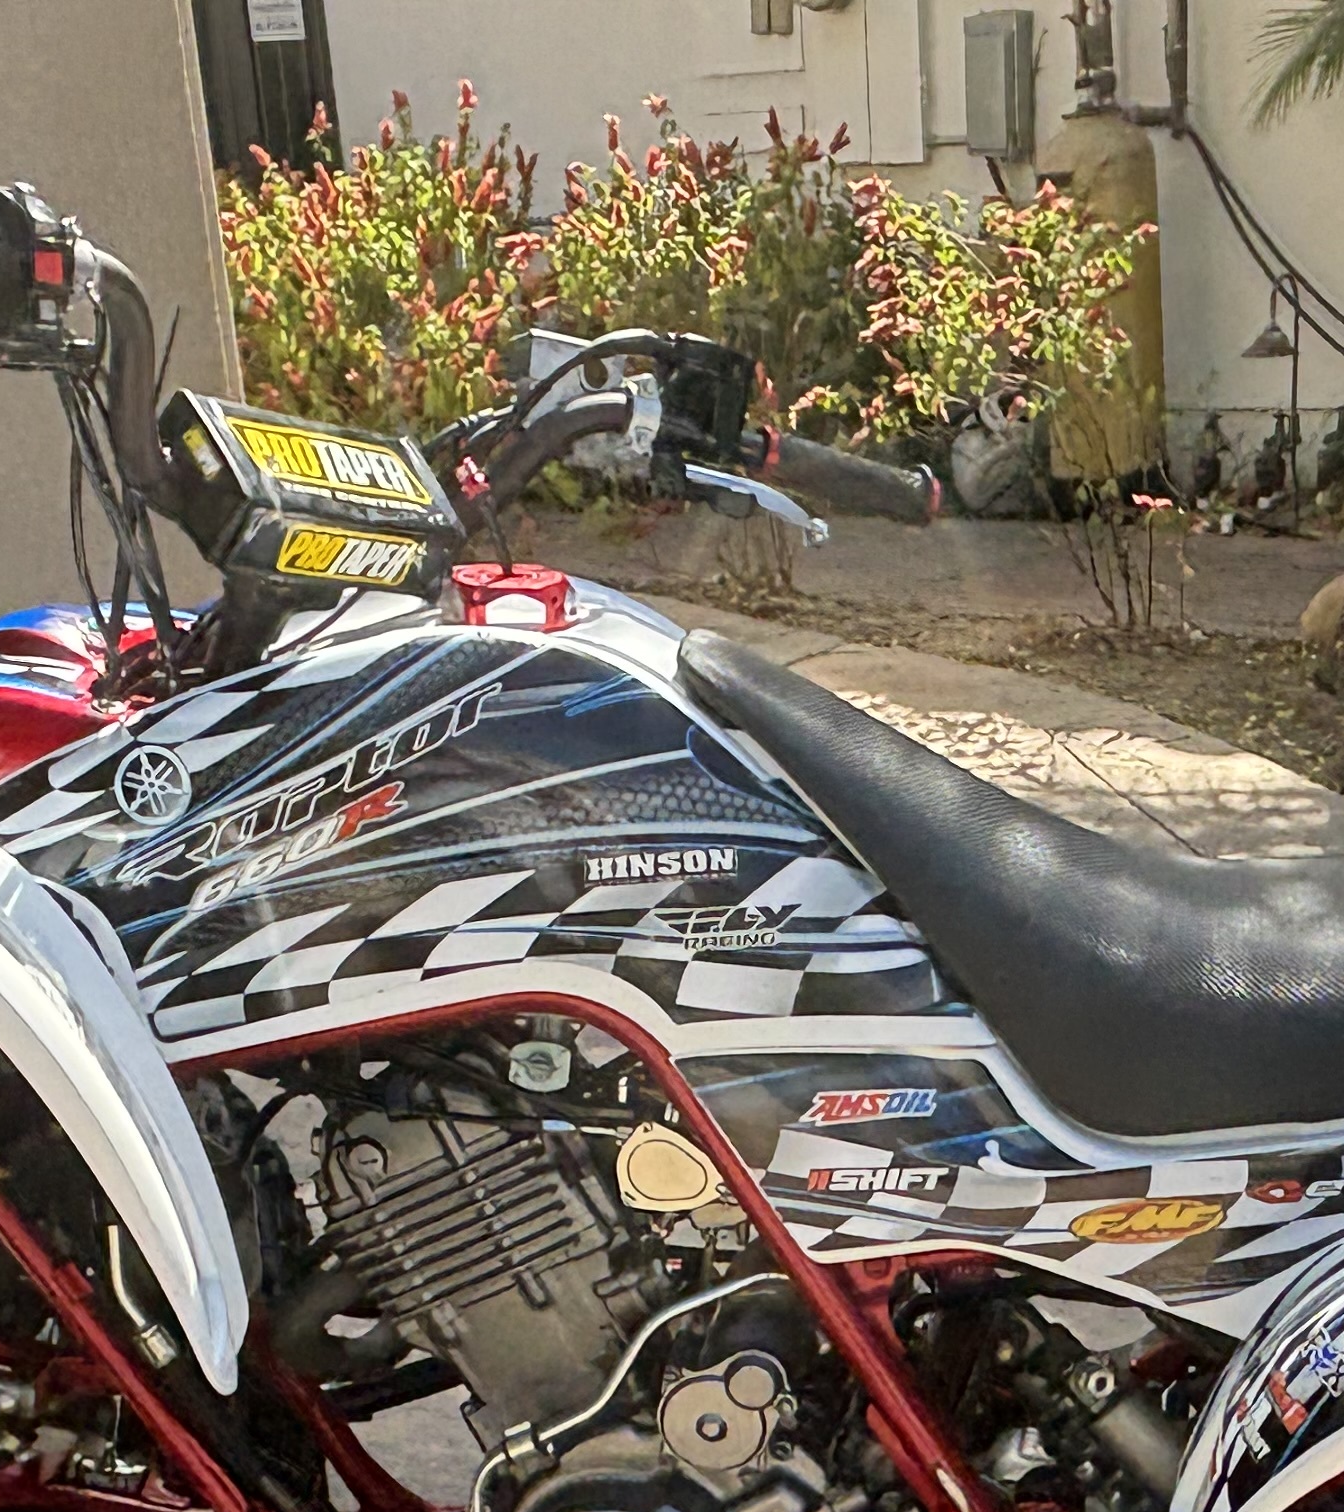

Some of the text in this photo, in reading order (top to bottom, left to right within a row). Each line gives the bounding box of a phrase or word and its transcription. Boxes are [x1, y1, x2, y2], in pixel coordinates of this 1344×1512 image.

[587, 848, 735, 881] HINSON
[684, 932, 776, 951] RACING
[809, 1092, 932, 1122] AMSOIL
[828, 1167, 950, 1191] SHIFT
[1071, 1203, 1223, 1237] FMF
